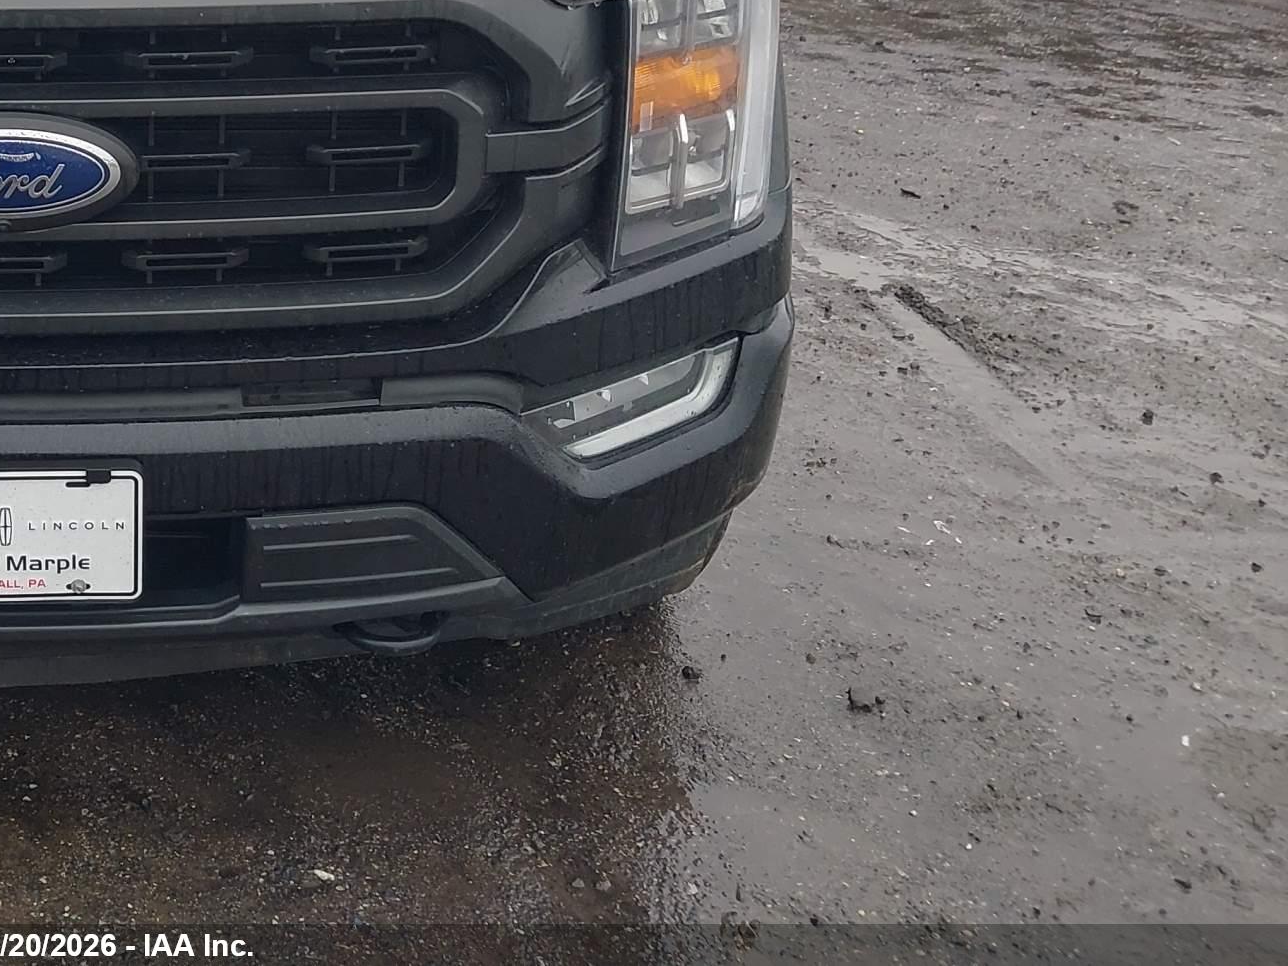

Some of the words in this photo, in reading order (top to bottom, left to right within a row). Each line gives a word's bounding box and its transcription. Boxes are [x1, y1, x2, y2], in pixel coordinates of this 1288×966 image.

[28, 521, 126, 531] LINCOLN
[6, 555, 91, 574] Marple
[28, 579, 47, 588] PA
